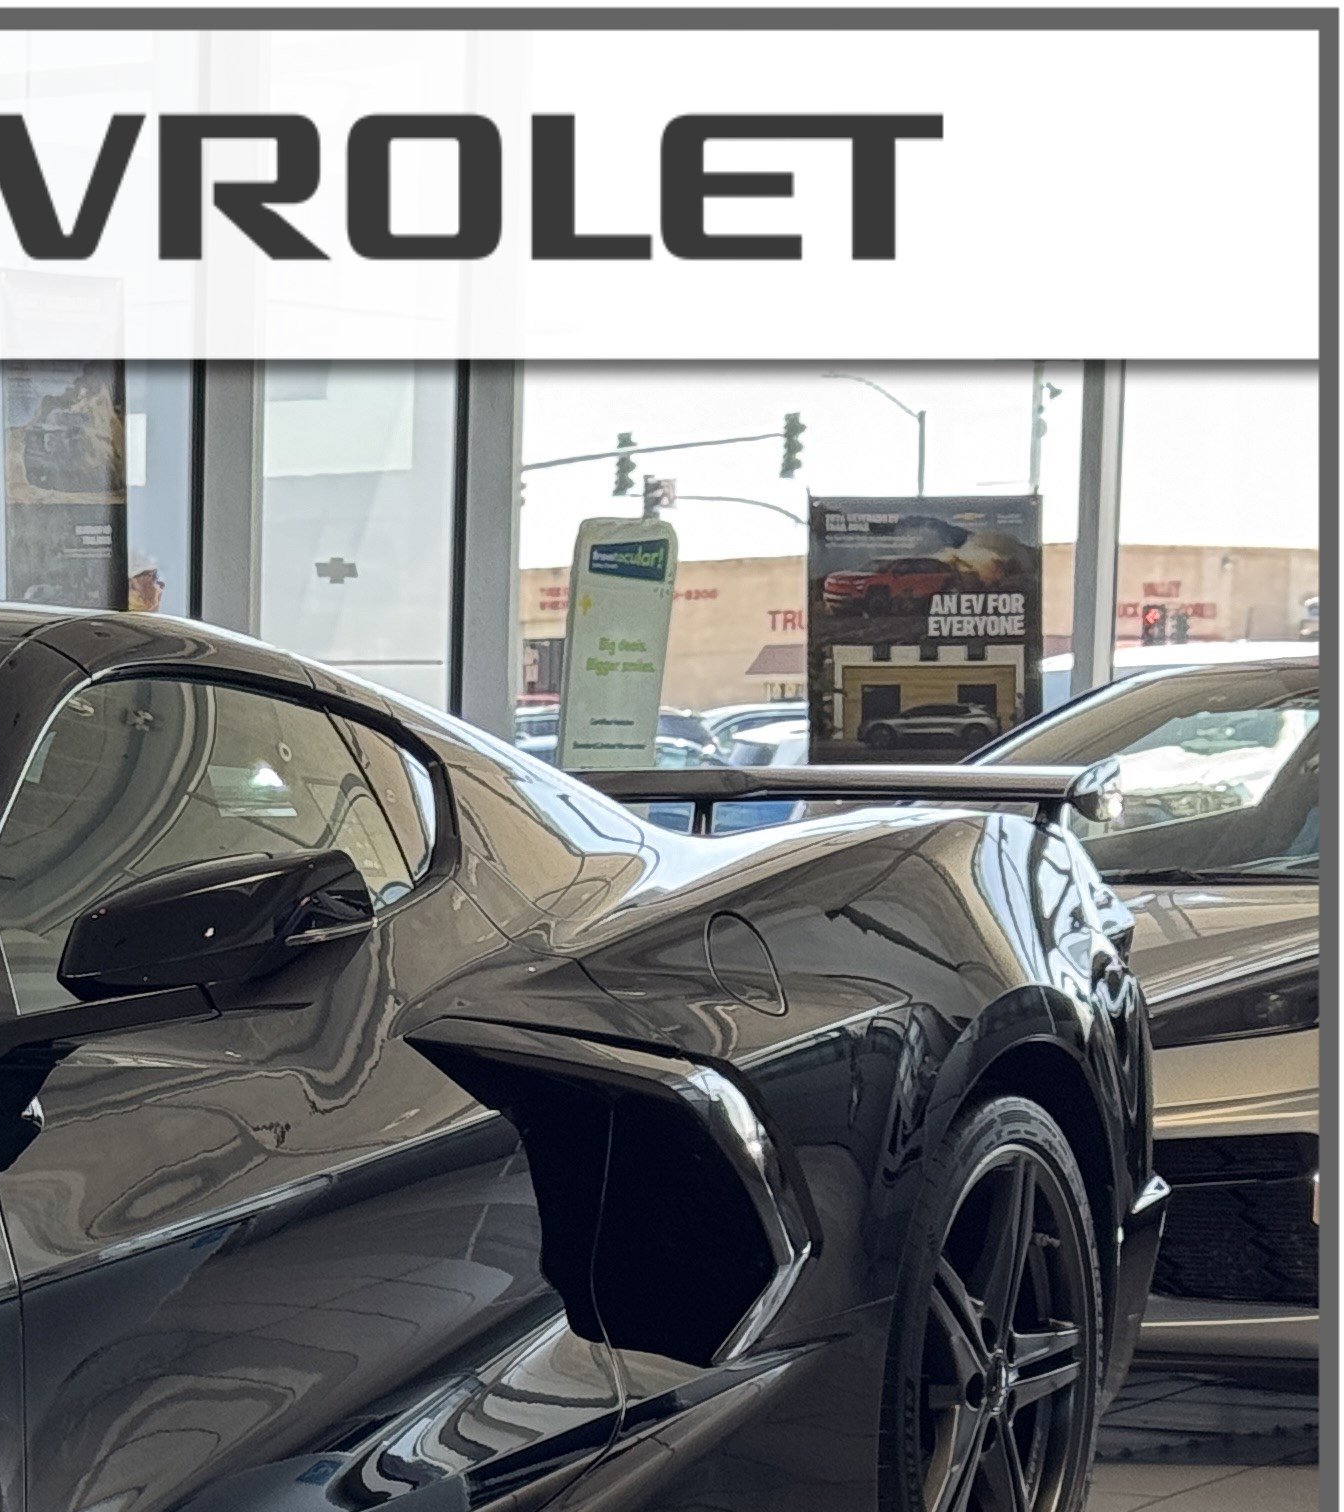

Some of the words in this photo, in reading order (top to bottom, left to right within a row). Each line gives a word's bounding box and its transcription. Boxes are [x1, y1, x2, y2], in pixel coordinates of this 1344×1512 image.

[929, 594, 959, 615] AN
[961, 594, 986, 615] EV
[987, 593, 1025, 614] FOR
[927, 615, 1026, 637] EVERYONE
